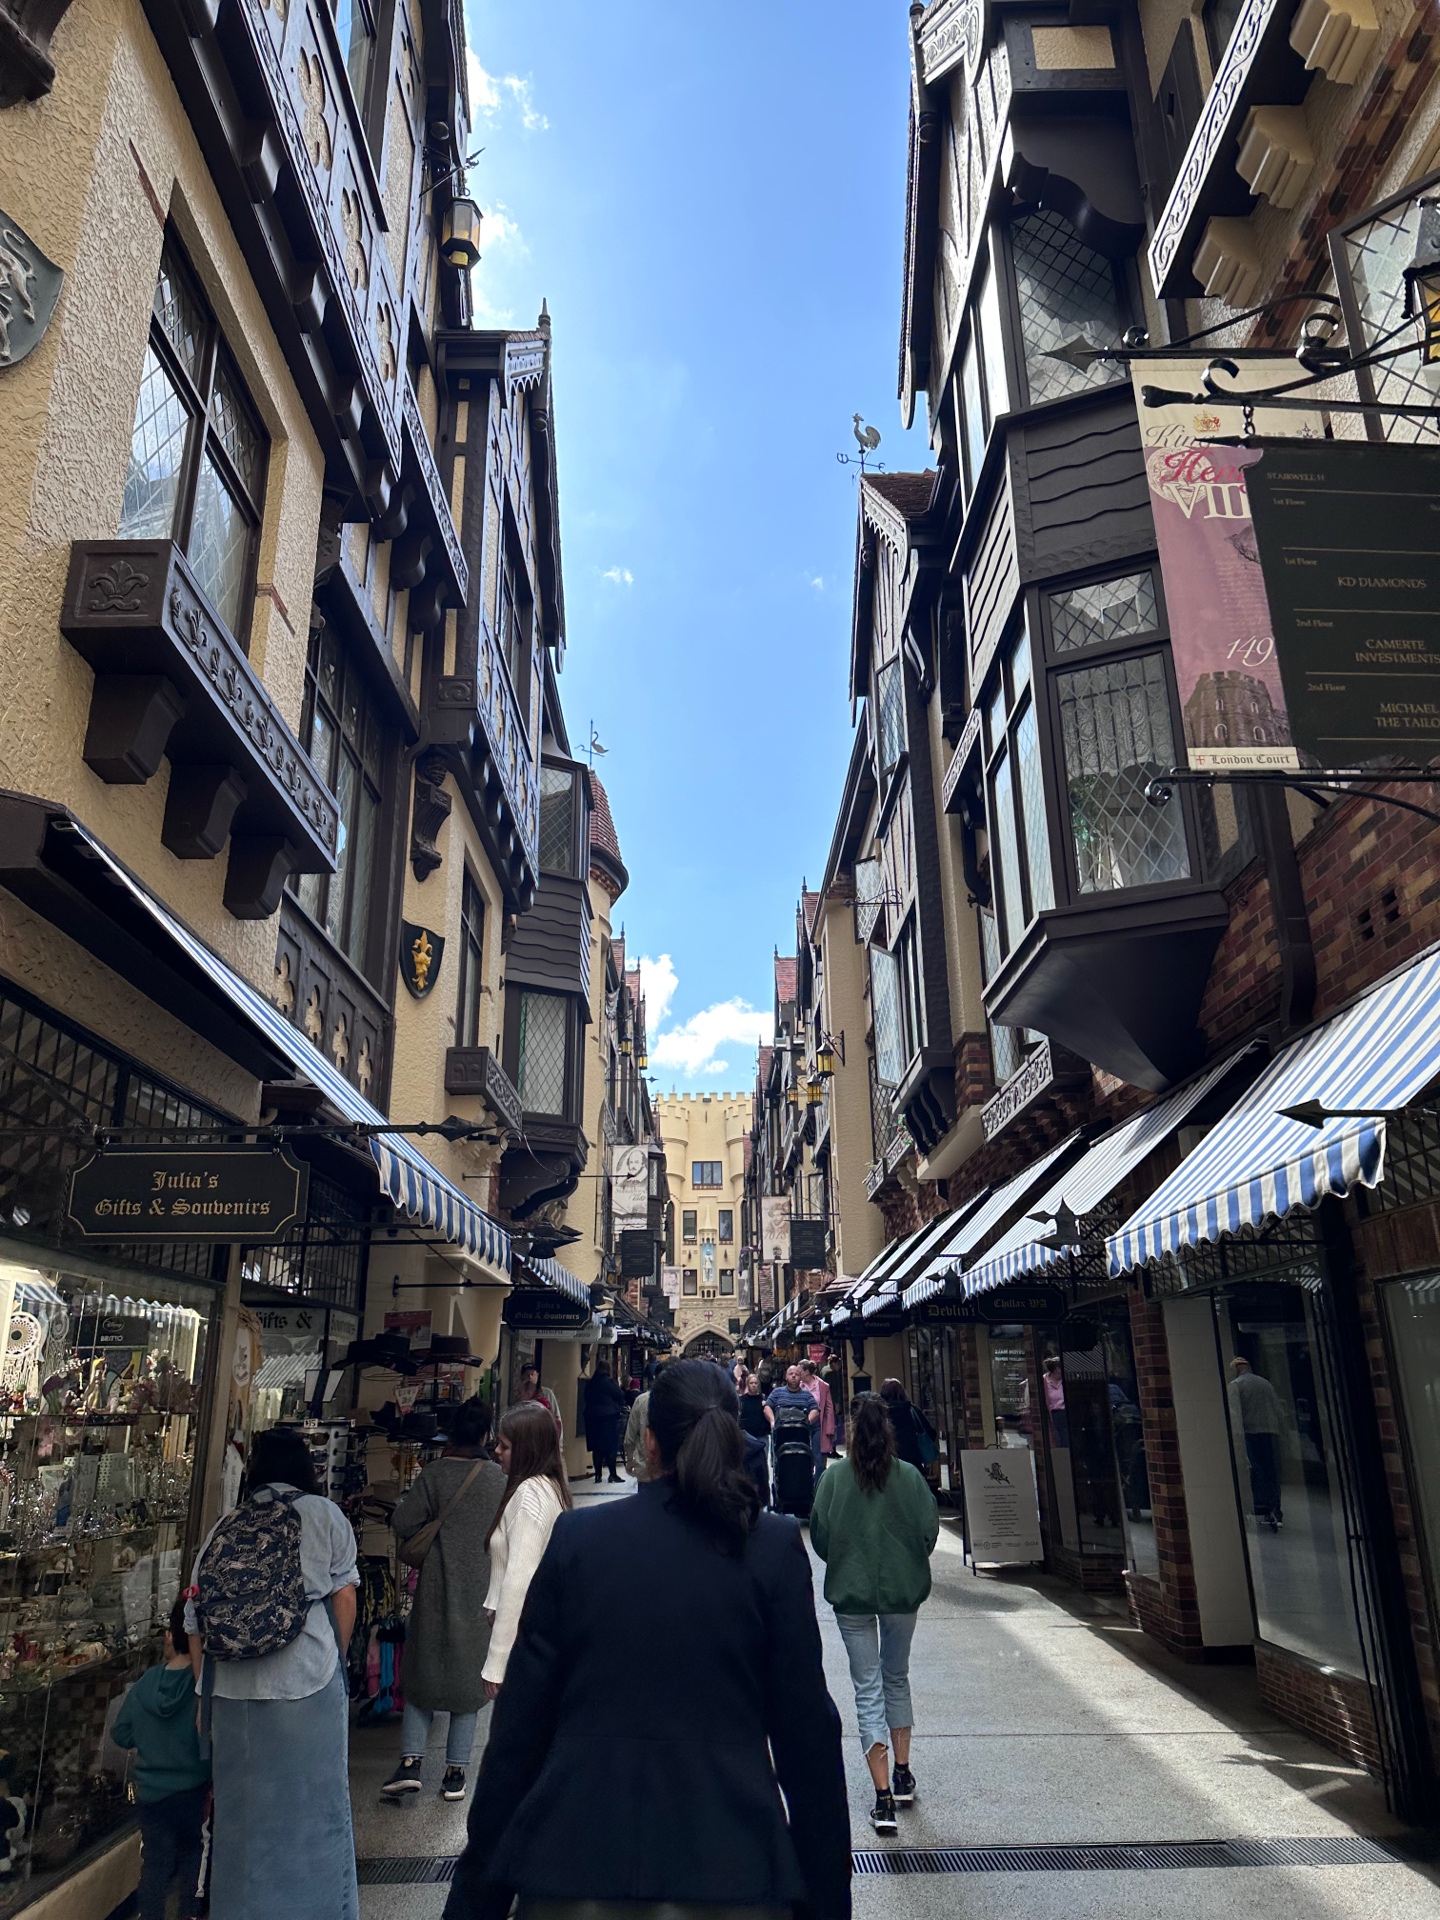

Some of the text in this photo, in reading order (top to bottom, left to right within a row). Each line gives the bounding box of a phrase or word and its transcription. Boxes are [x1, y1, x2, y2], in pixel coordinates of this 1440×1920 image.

[1161, 447, 1244, 484] Hen
[1266, 472, 1315, 481] STAIRWELL
[1285, 498, 1306, 506] Floor
[1284, 557, 1318, 566] 1st Floor
[1337, 576, 1427, 589] KD DIAMONDS
[1296, 619, 1334, 627] 2nd Floor
[1365, 639, 1426, 650] CAMERTE
[1226, 635, 1278, 667] 149
[1355, 651, 1440, 664] INVESTMENTS
[1307, 683, 1346, 691] 2nd Floor
[1380, 703, 1440, 714] MICHAEL
[1375, 716, 1400, 728] THE
[1210, 754, 1291, 765] London Court
[151, 1171, 219, 1191] Julia's
[95, 1198, 271, 1216] Gifts & Souvenirs
[993, 1298, 1047, 1308] Chillax WA
[296, 1311, 313, 1329] &
